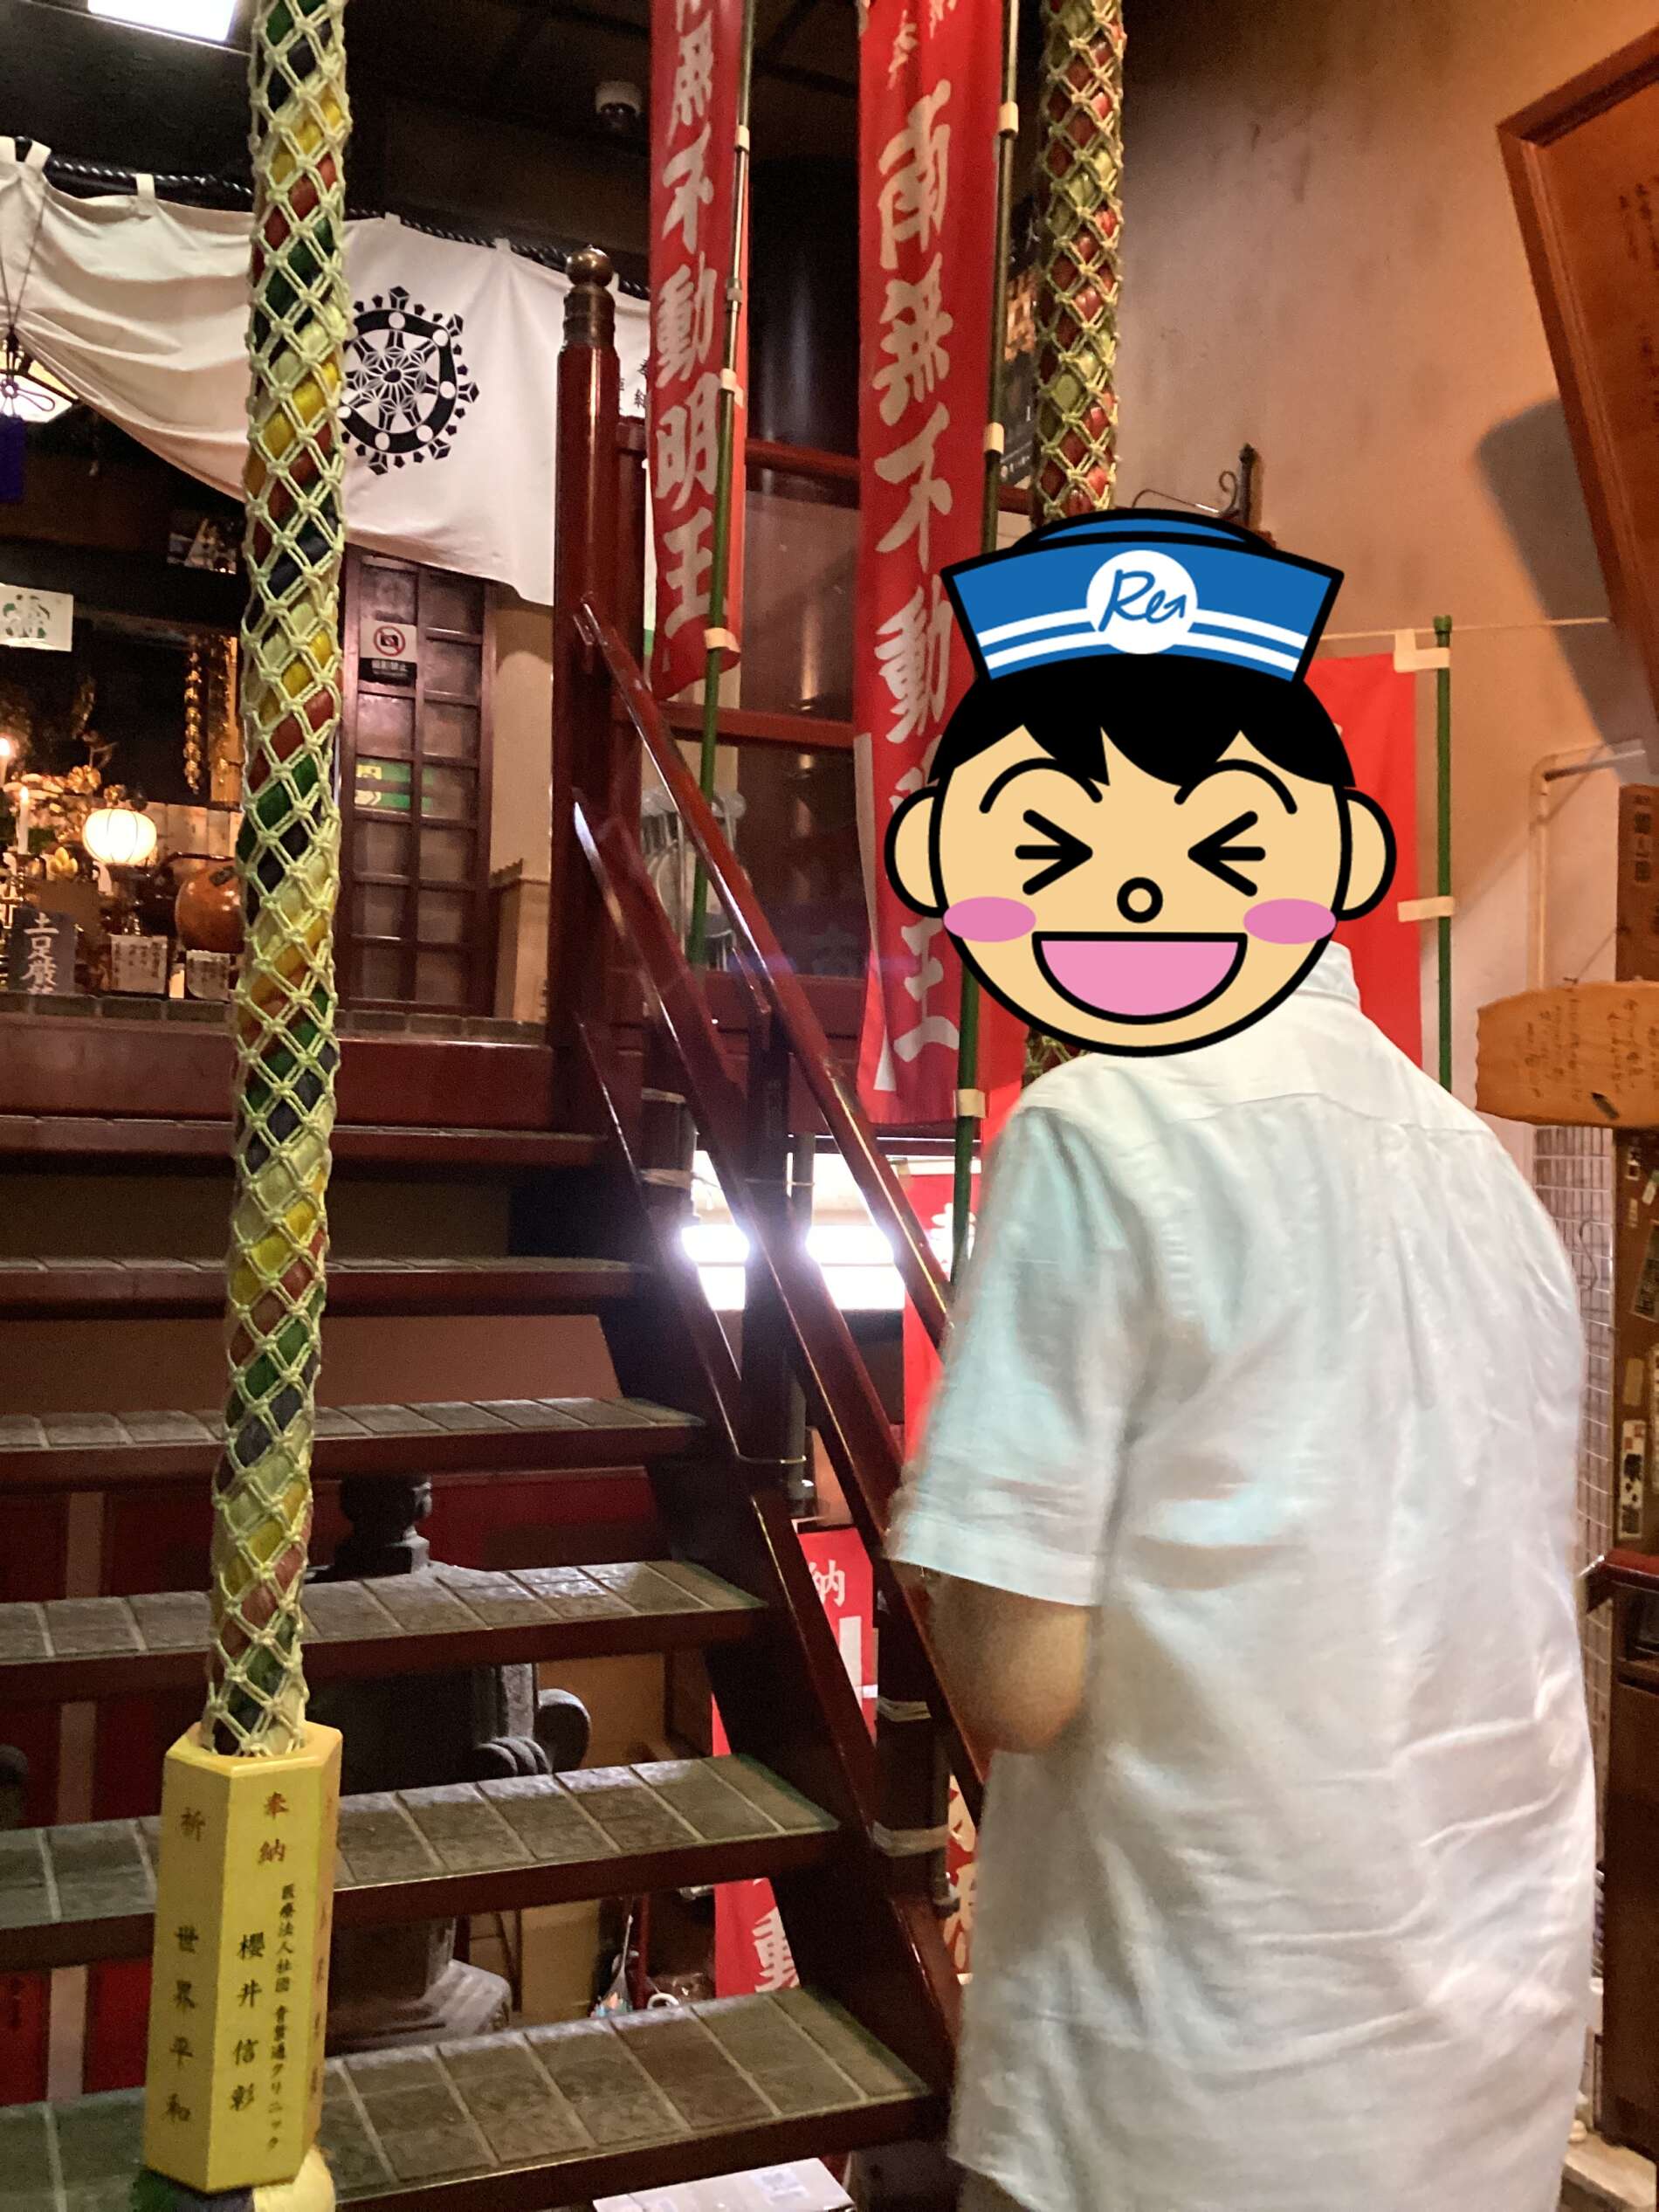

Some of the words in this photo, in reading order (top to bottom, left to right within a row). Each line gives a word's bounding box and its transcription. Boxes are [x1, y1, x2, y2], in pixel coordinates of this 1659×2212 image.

[655, 0, 728, 640] 無不動明王
[873, 79, 959, 1063] 南無不動王
[181, 1807, 206, 1842] 祈
[258, 1791, 290, 1864] 奉納
[165, 1926, 200, 2125] 世界平和
[229, 1932, 265, 2112] 櫻井信彰
